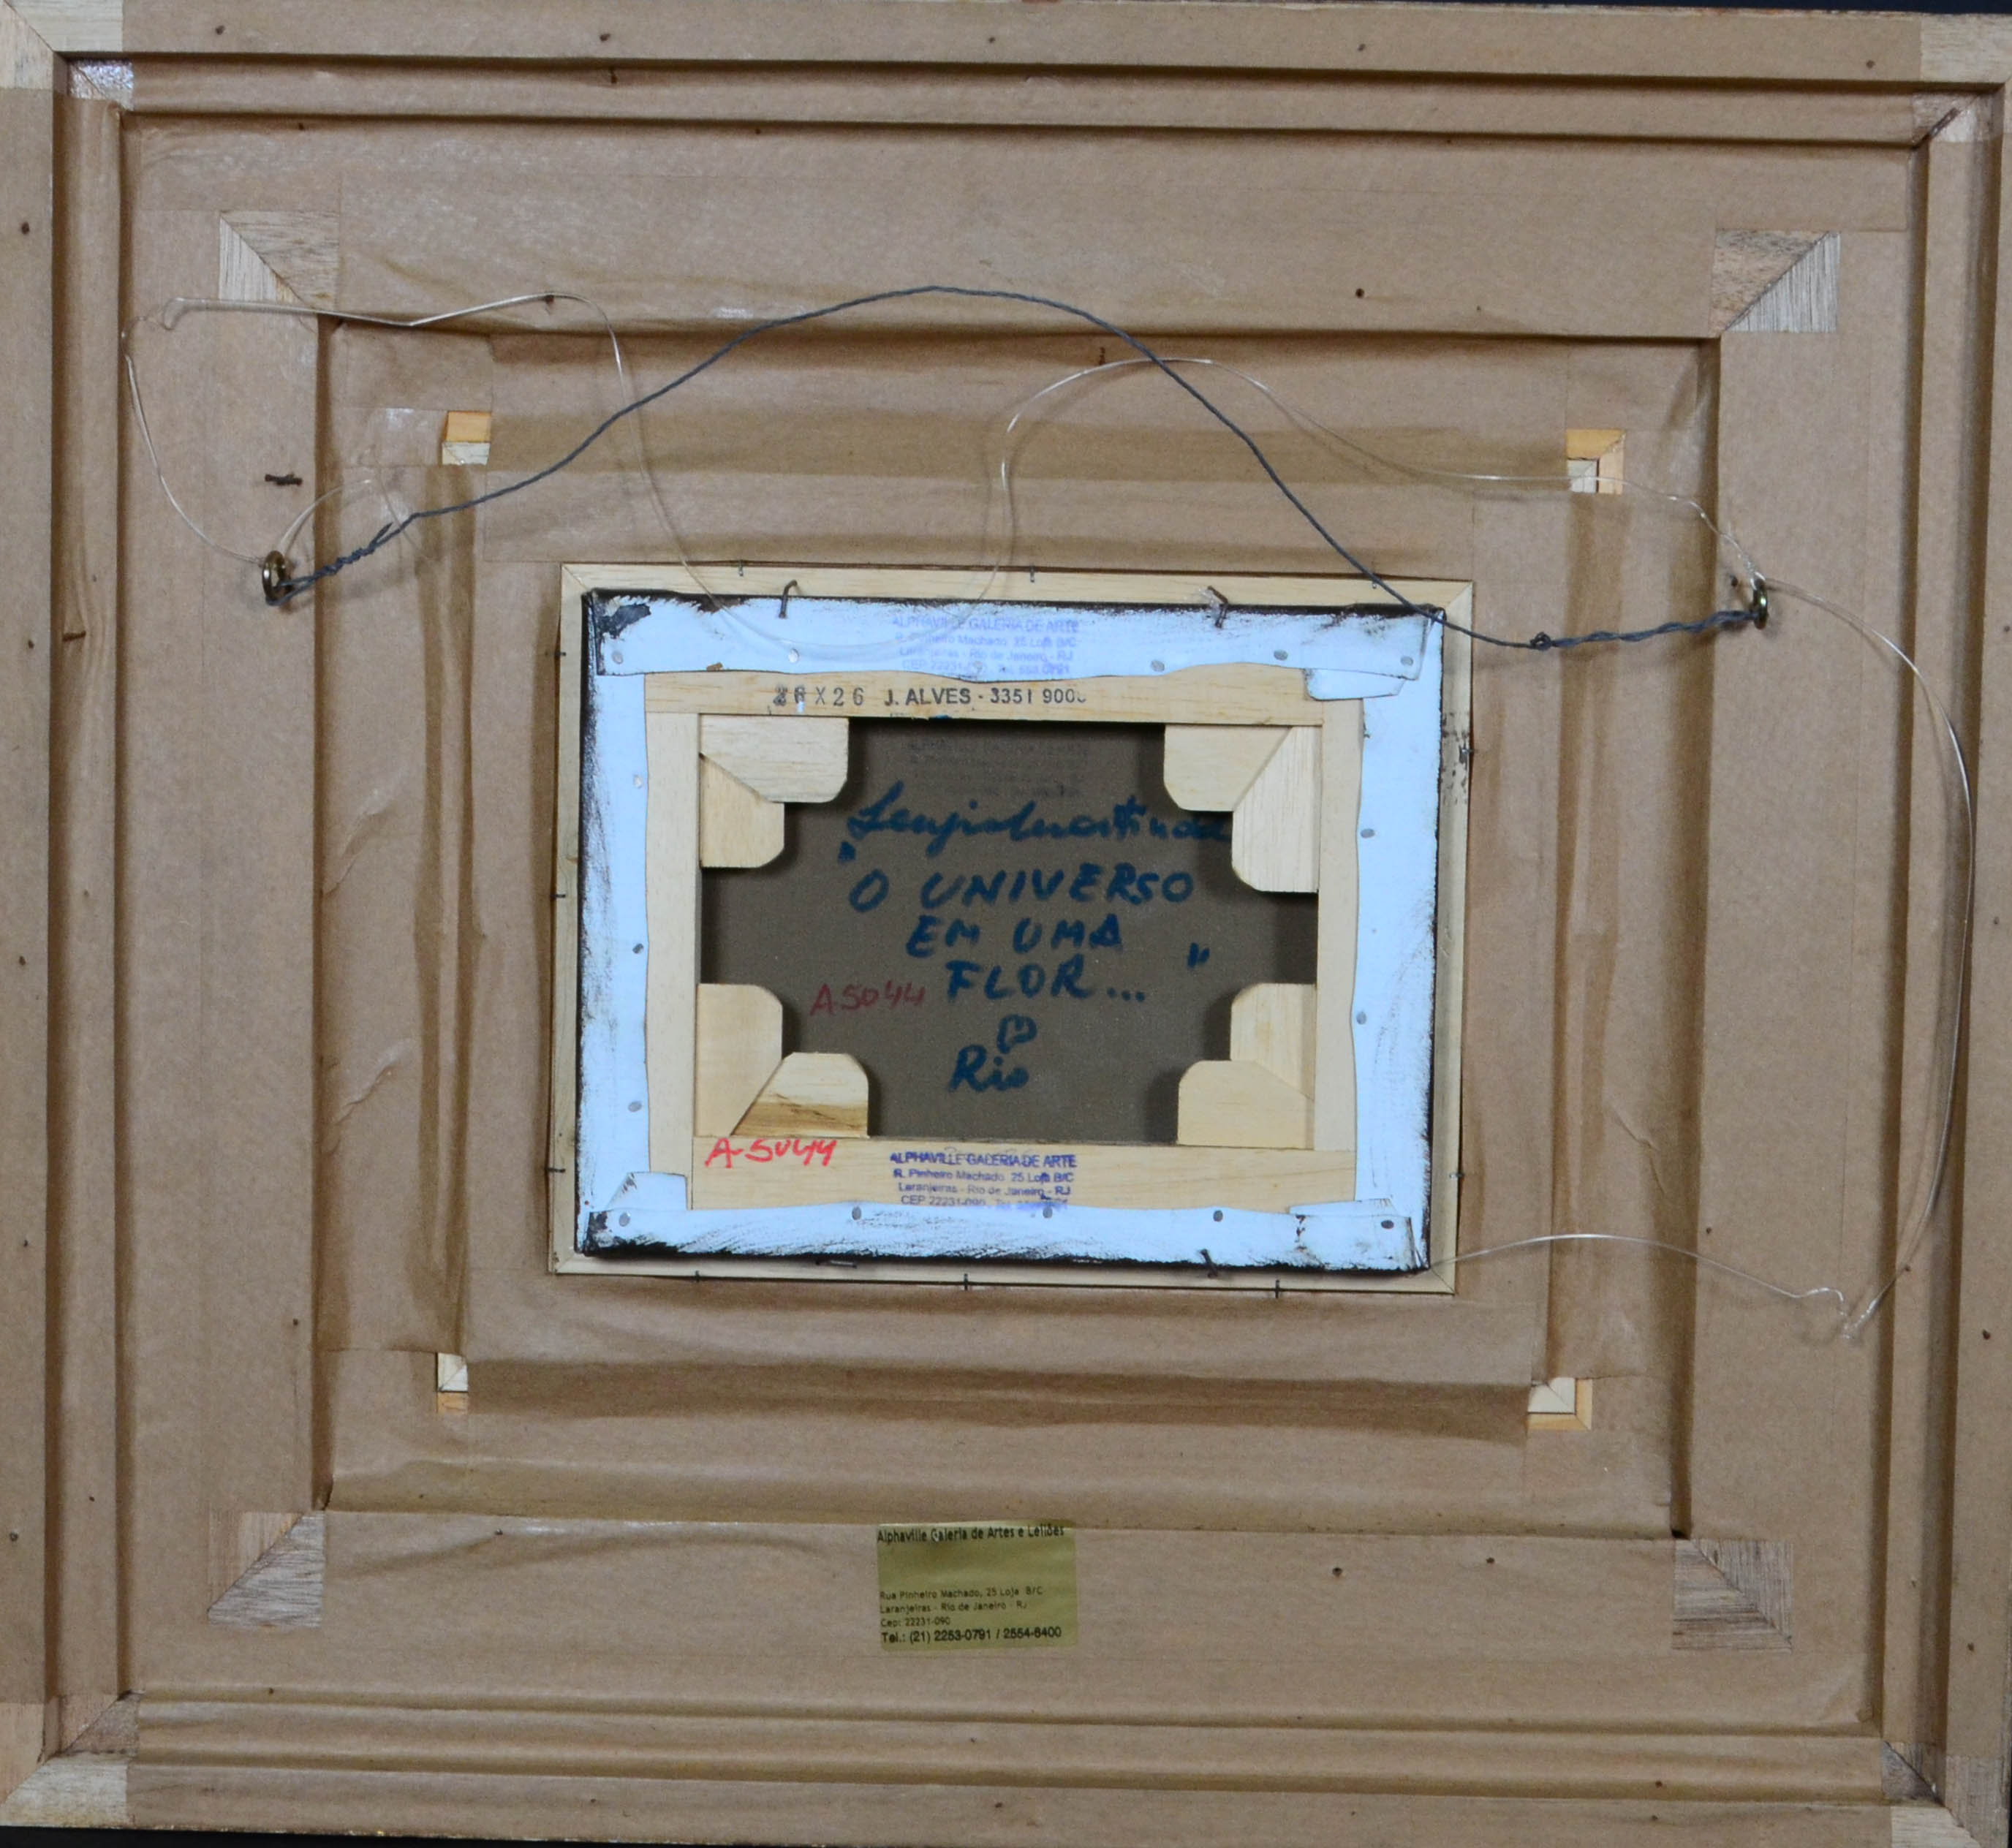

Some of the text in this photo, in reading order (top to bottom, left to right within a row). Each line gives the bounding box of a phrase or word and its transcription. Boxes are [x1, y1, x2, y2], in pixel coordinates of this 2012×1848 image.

[1047, 620, 1078, 632] ARTE
[906, 688, 971, 705] ALVES
[920, 863, 1194, 909] UNIVERSO
[906, 912, 1122, 958] EM UMA
[948, 1043, 1029, 1092] Rio
[890, 1151, 1078, 1167] ALPHAVILLE GALERIA DE ARTE
[909, 1168, 954, 1179] Pinheiro
[956, 1170, 1005, 1182] Machado
[1010, 1172, 1024, 1182] 25
[898, 1181, 958, 1193] Laranjeiras
[967, 1184, 986, 1194] Rio
[1055, 1185, 1071, 1195] RJ
[901, 1195, 925, 1205] CEP
[877, 1529, 927, 1545] Alphaville
[931, 1528, 967, 1542] Galeria
[971, 1528, 984, 1540] de
[987, 1525, 1015, 1539] Artes
[1018, 1528, 1024, 1537] e
[880, 1591, 896, 1600] Rua
[900, 1590, 937, 1599] Pinheiro
[986, 1588, 998, 1597] 25
[1000, 1588, 1019, 1599] Loja
[880, 1603, 931, 1615] Laranjeiras
[941, 1603, 955, 1612] Rio
[958, 1602, 969, 1611] de
[974, 1601, 1007, 1610] Janeiro
[904, 1616, 951, 1627] 22231-090
[882, 1632, 906, 1643] Tel.:
[909, 1631, 931, 1645] (21)
[934, 1628, 991, 1642] 2253-0791
